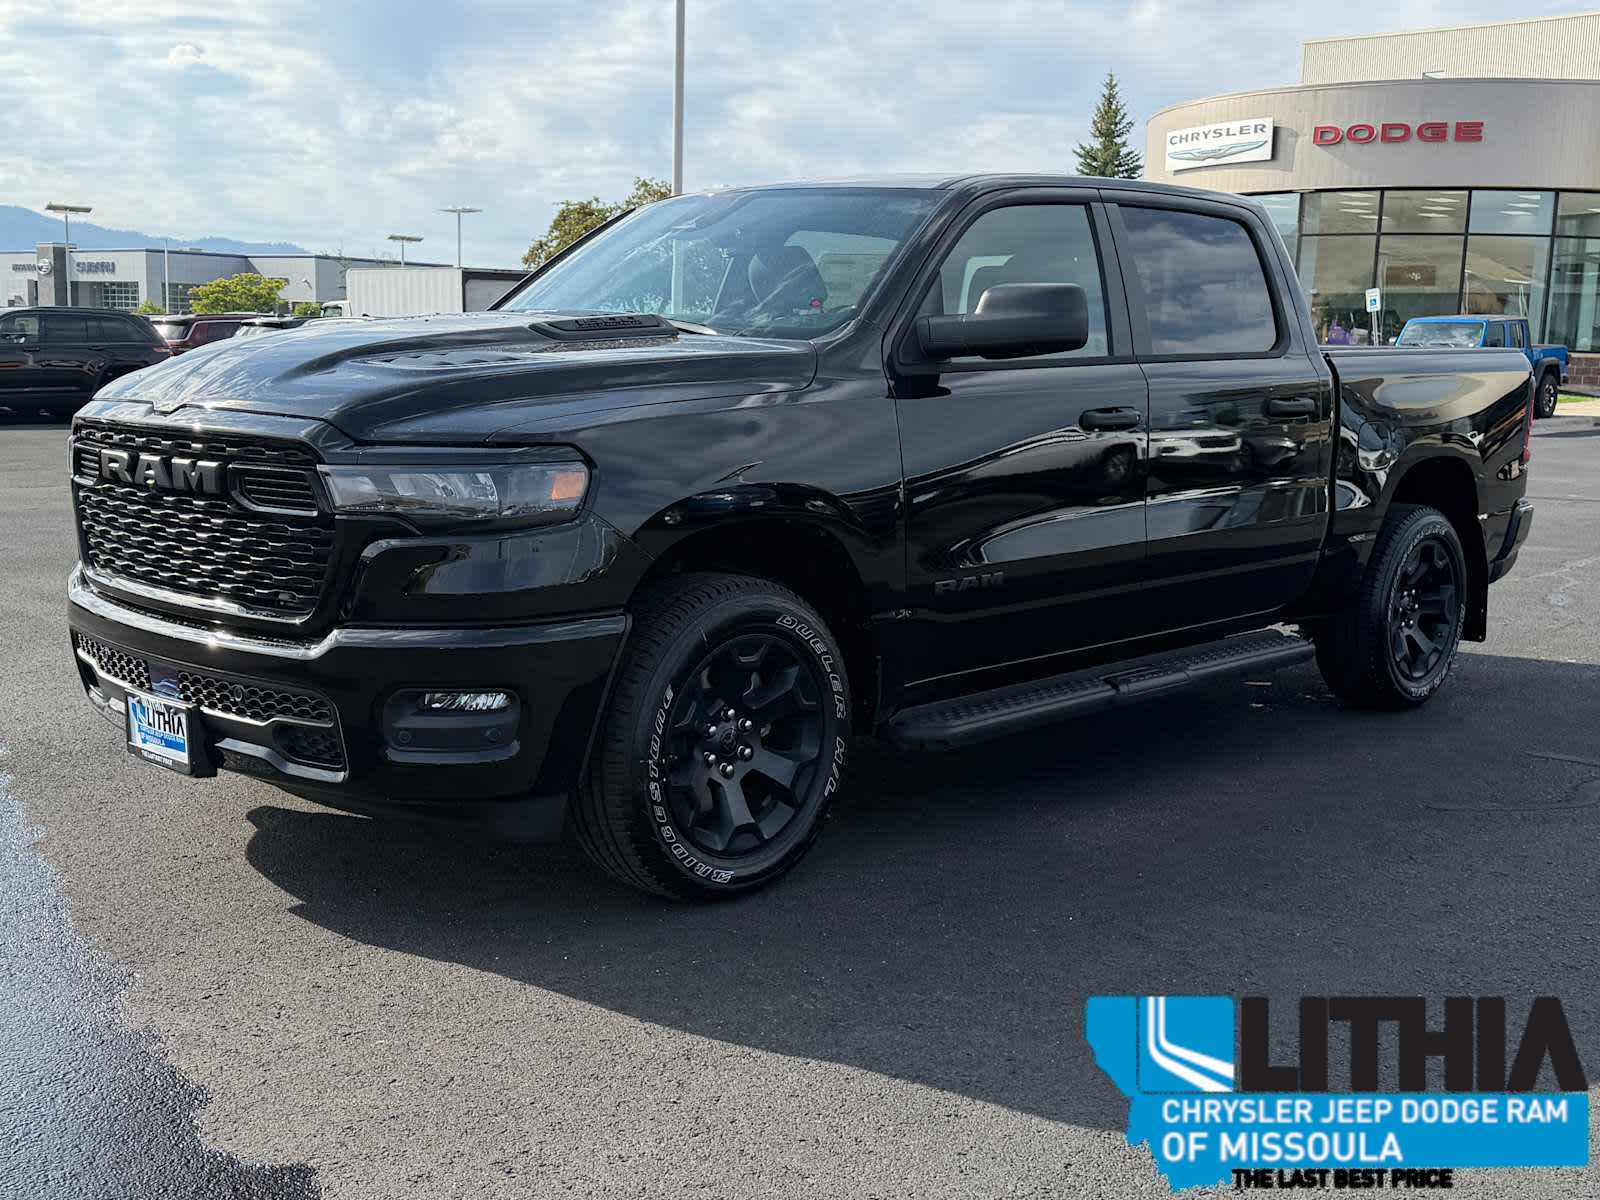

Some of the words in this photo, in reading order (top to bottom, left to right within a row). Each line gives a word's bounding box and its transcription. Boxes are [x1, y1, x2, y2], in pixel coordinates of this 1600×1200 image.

[1169, 123, 1267, 145] CHRYSLER
[1313, 121, 1484, 145] DODGE
[100, 450, 221, 494] RAM
[935, 571, 1004, 593] RAM
[776, 614, 846, 719] DUELER
[146, 707, 185, 737] LITHIA
[649, 684, 735, 884] BRIDGESTONE
